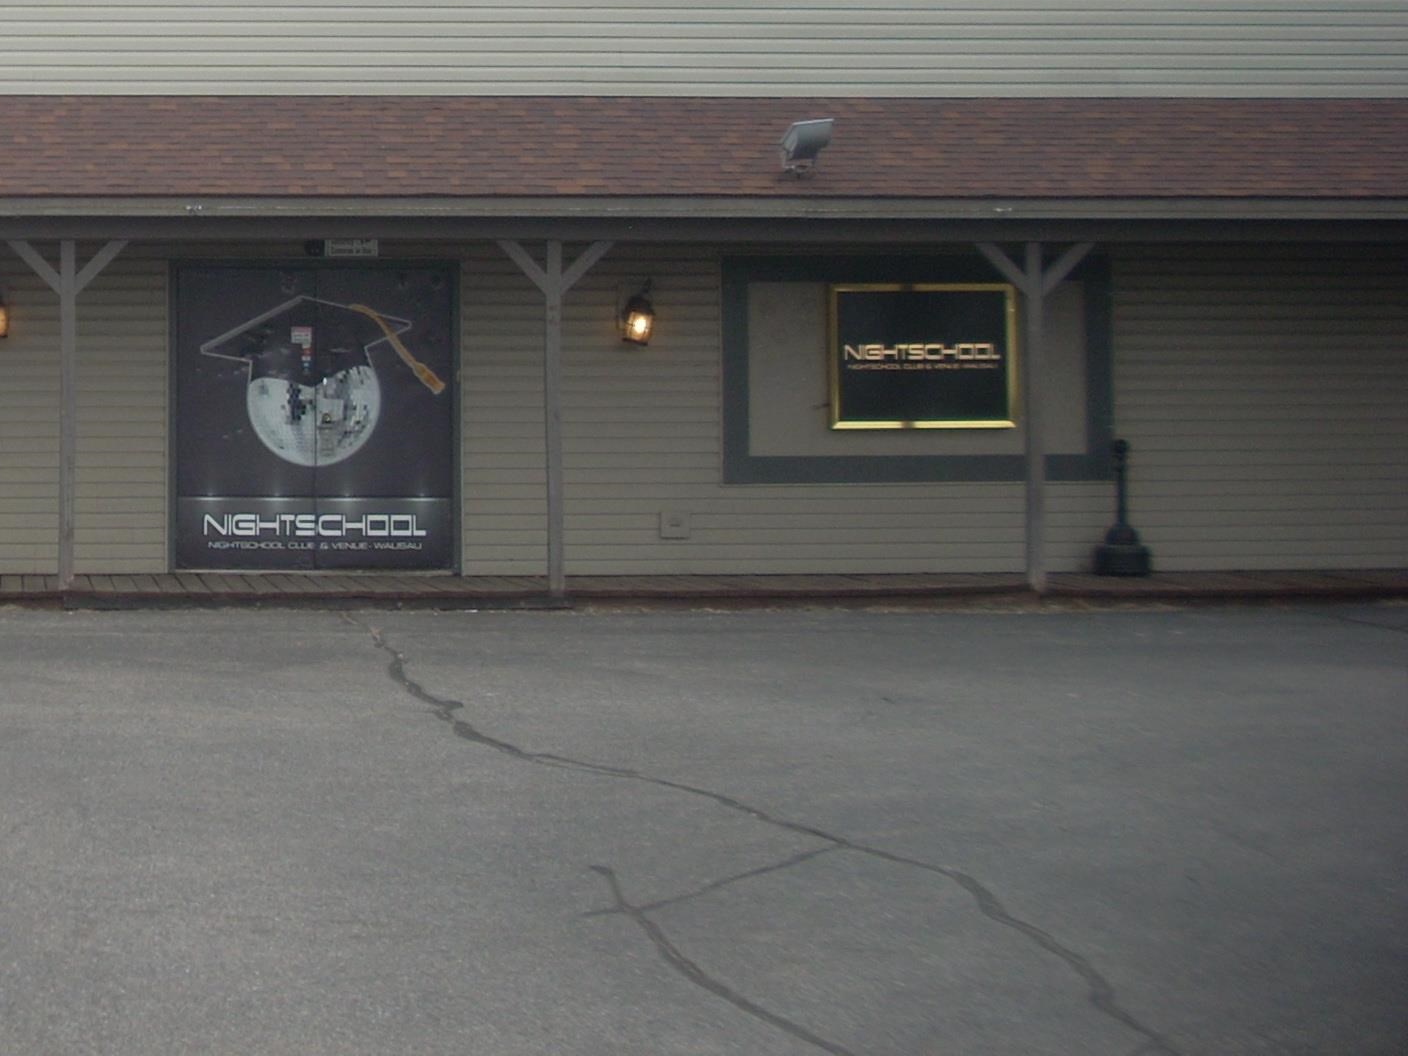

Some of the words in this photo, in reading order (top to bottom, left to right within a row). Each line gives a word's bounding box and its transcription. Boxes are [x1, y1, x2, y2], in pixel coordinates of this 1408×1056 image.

[844, 343, 1001, 361] NIGHTSCHOOL
[203, 513, 427, 537] NIGHTSCHOOL
[208, 541, 286, 550] NIGHTSCHOOL
